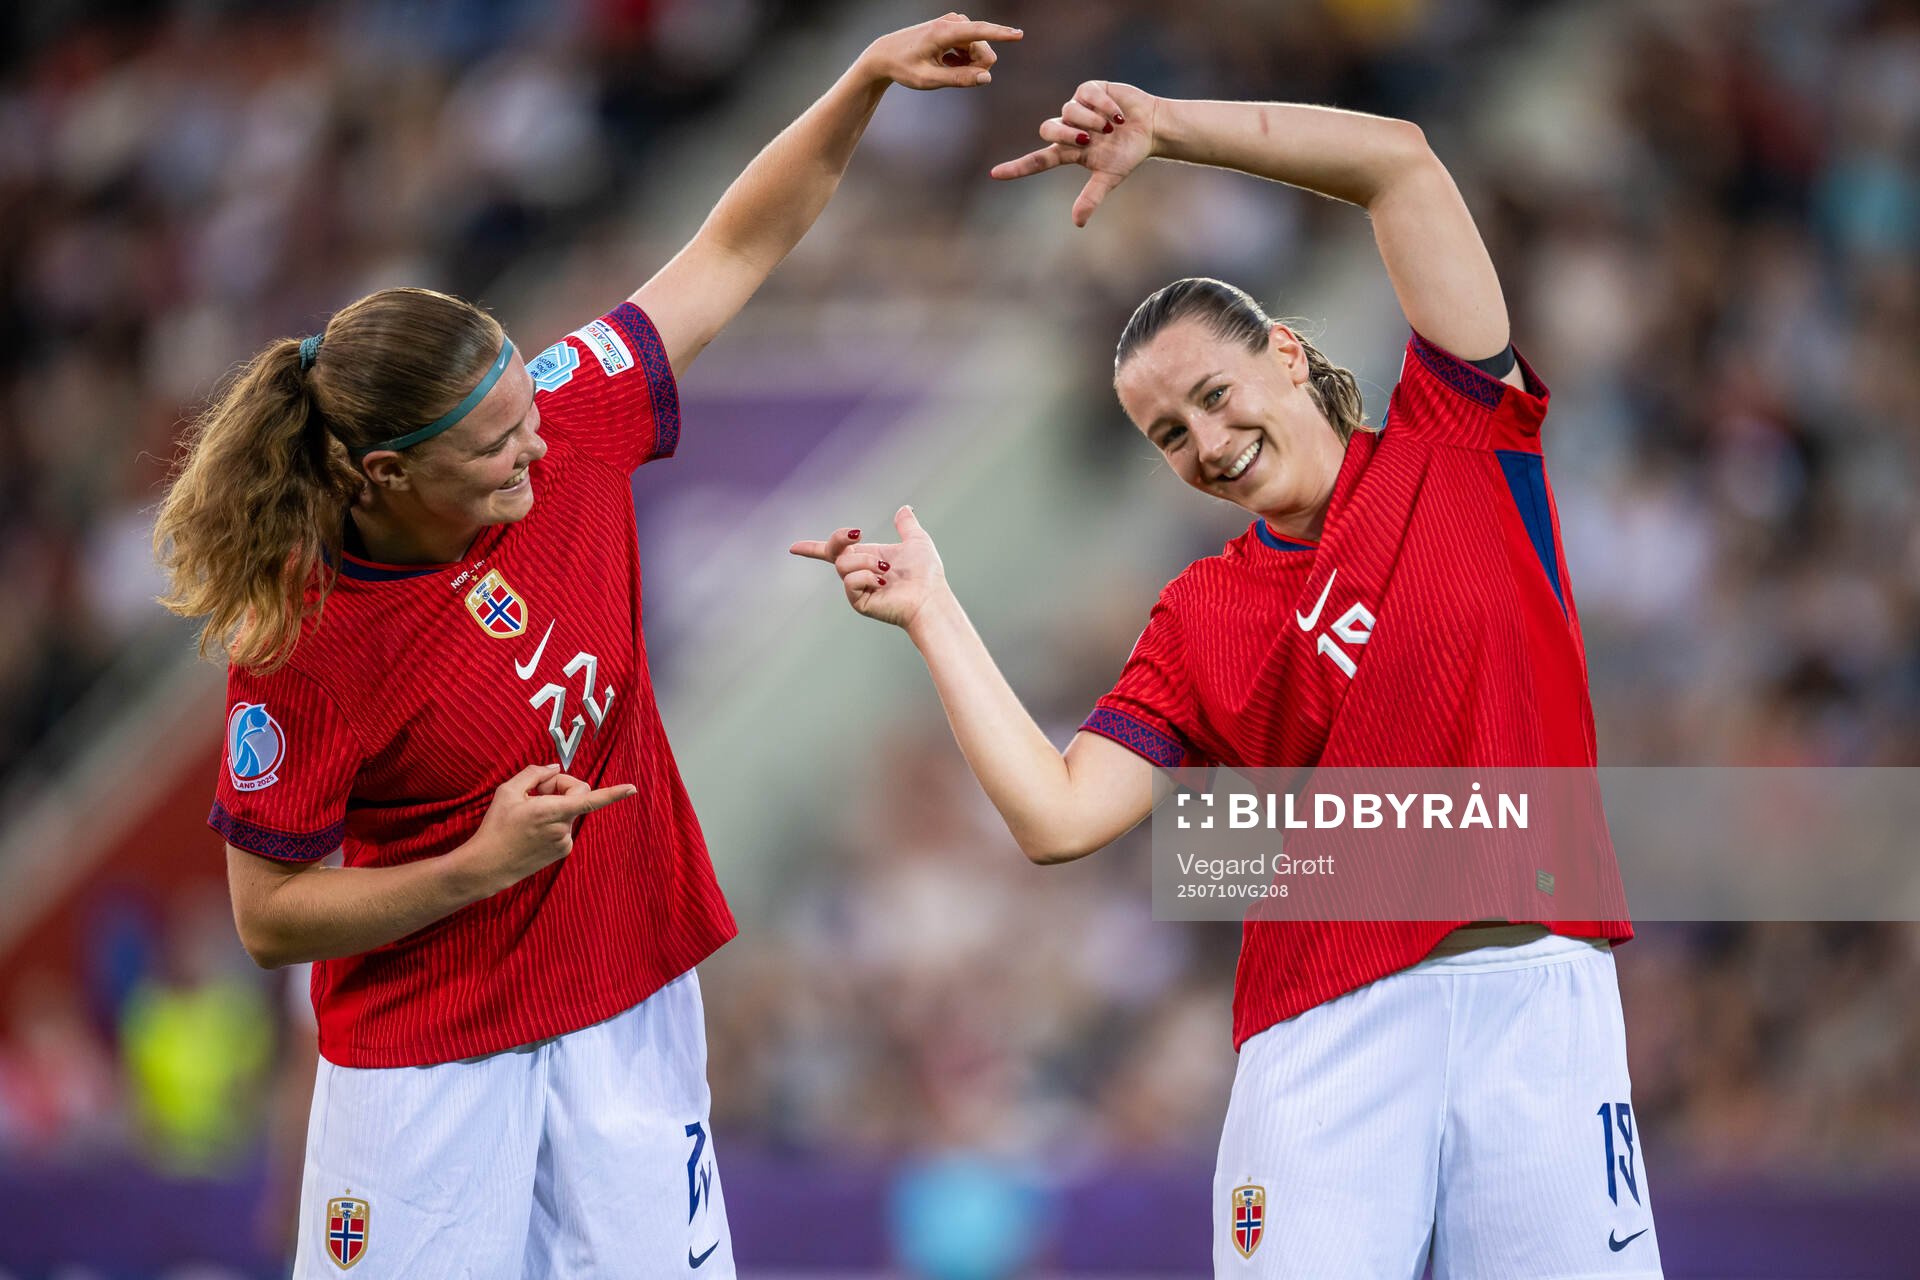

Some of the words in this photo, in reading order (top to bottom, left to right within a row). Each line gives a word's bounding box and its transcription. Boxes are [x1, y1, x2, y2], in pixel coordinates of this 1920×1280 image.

[587, 326, 625, 370] FOUNDATIO
[450, 571, 471, 589] NOR
[529, 651, 615, 772] 22
[257, 774, 275, 787] 2025
[1596, 1103, 1641, 1207] 19
